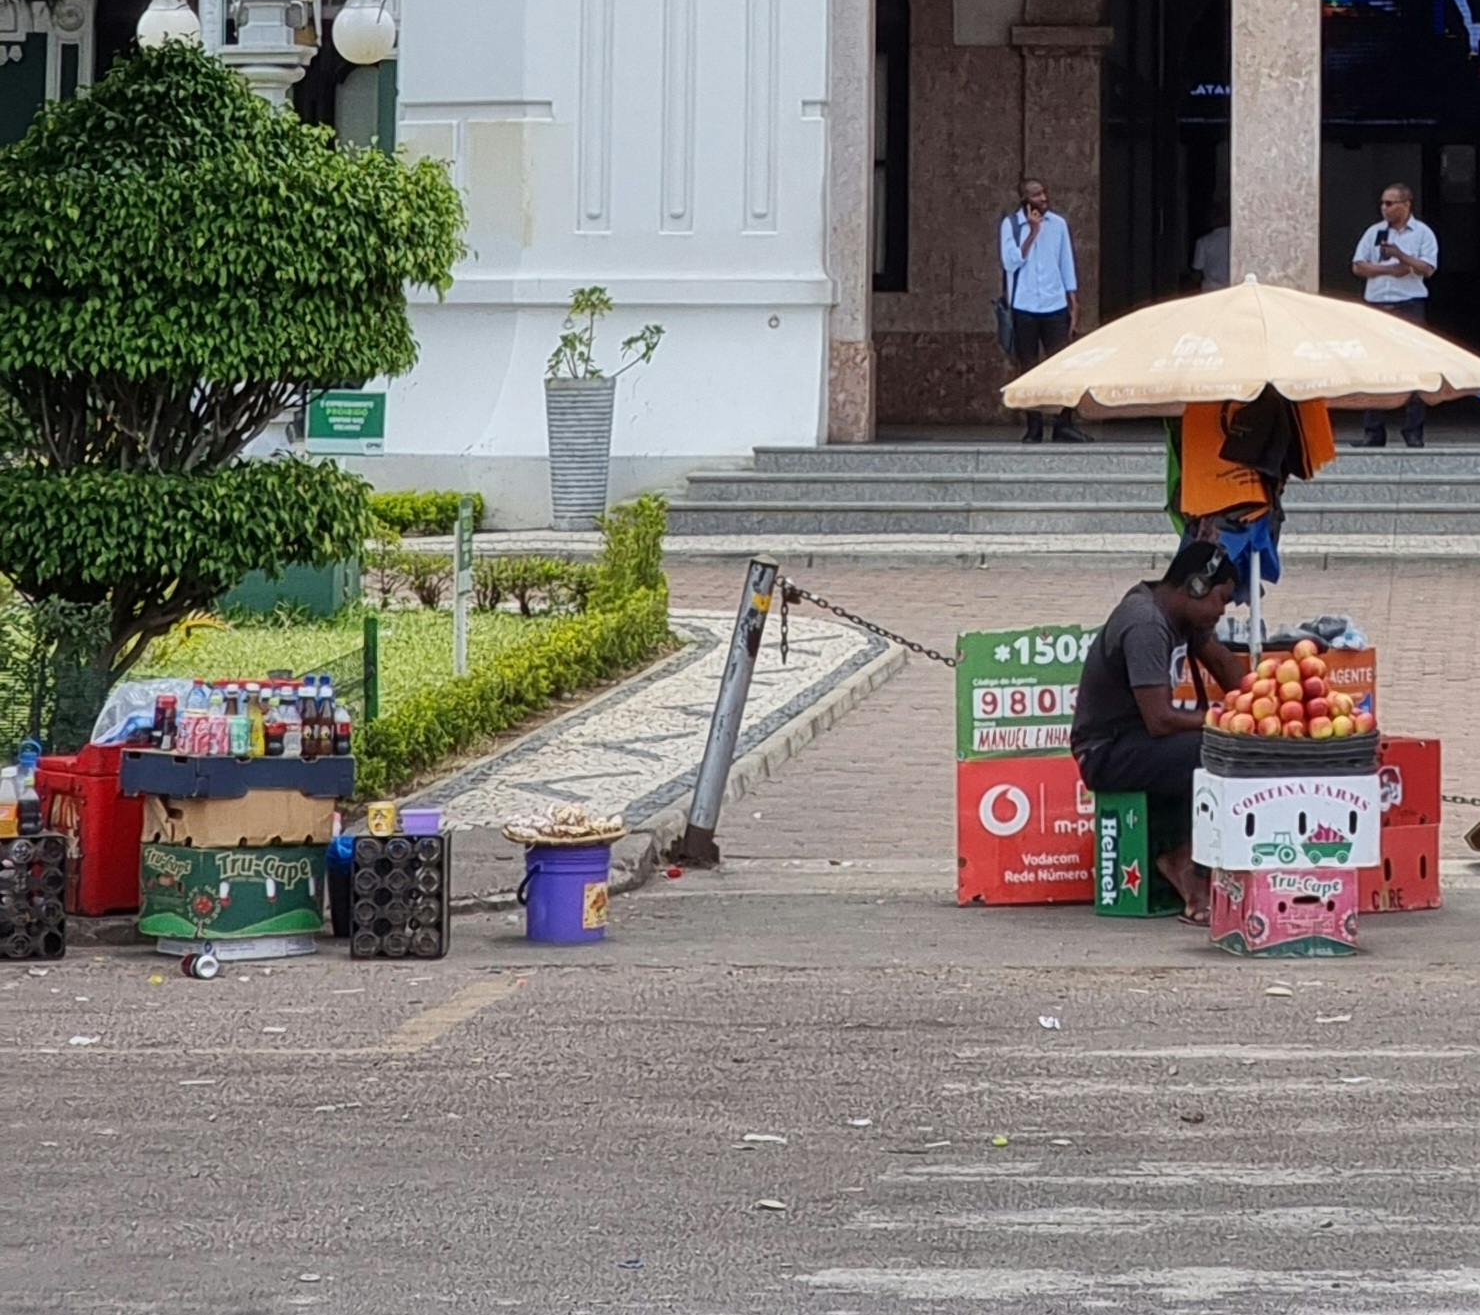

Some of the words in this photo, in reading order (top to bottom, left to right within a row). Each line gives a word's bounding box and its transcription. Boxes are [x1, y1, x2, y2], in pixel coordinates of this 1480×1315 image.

[1328, 668, 1373, 684] AGENTE
[1232, 783, 1306, 816] CORTINA
[1314, 782, 1371, 812] FARMS
[1022, 852, 1080, 865] Vodacom
[216, 851, 314, 890] Tru-Cape
[1005, 870, 1035, 883] Rede
[1038, 868, 1088, 881] Número
[1268, 872, 1343, 897] Tru-Cape
